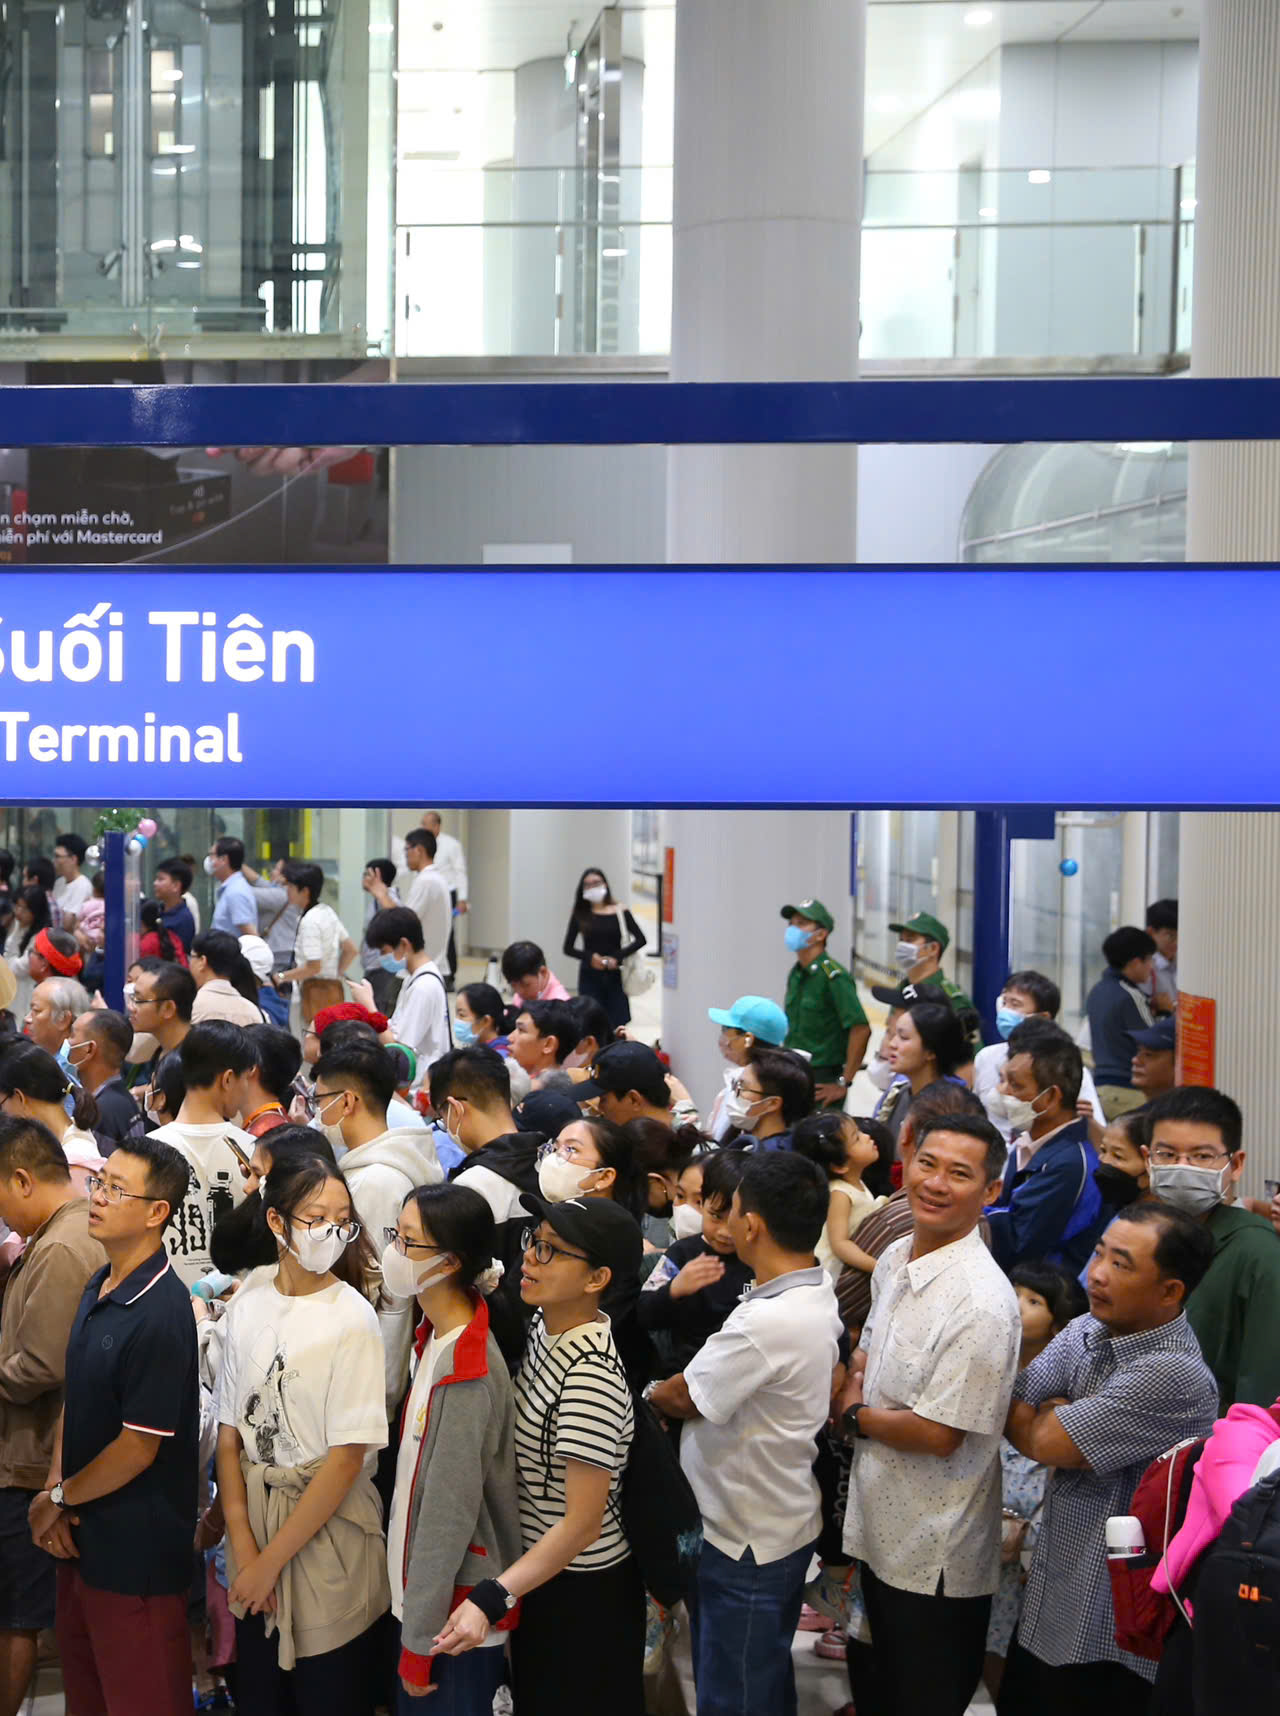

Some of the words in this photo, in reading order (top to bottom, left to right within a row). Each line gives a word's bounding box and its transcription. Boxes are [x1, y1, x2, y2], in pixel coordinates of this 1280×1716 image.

[14, 509, 57, 528] chạm
[61, 508, 99, 525] miễn
[26, 530, 50, 547] phí
[51, 529, 73, 544] với
[77, 529, 163, 544] Mastercard
[149, 612, 315, 682] Tiên
